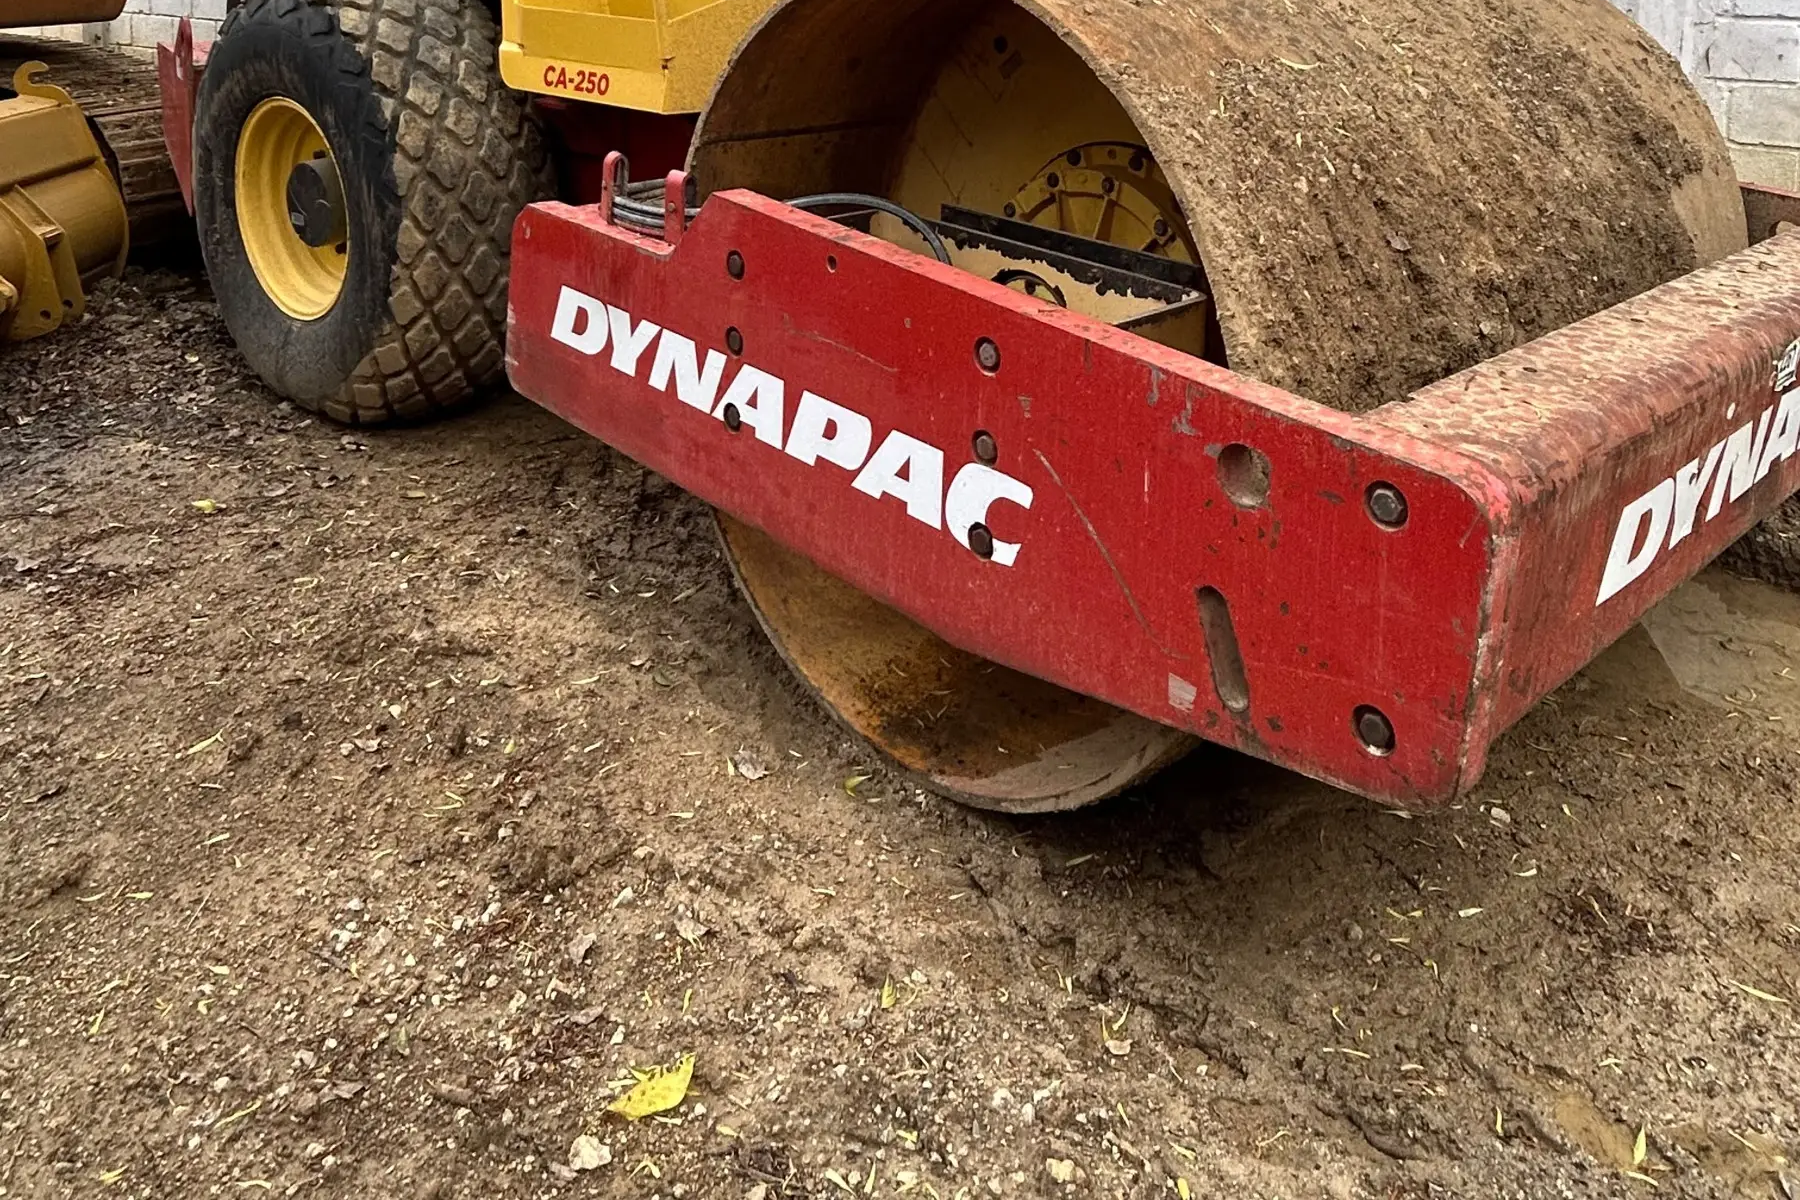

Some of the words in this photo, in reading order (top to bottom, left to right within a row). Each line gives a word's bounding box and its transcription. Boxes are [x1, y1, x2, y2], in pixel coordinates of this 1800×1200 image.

[543, 65, 610, 96] CA-250
[550, 285, 1034, 567] DYNAPAC
[1595, 386, 1800, 607] DYNA
